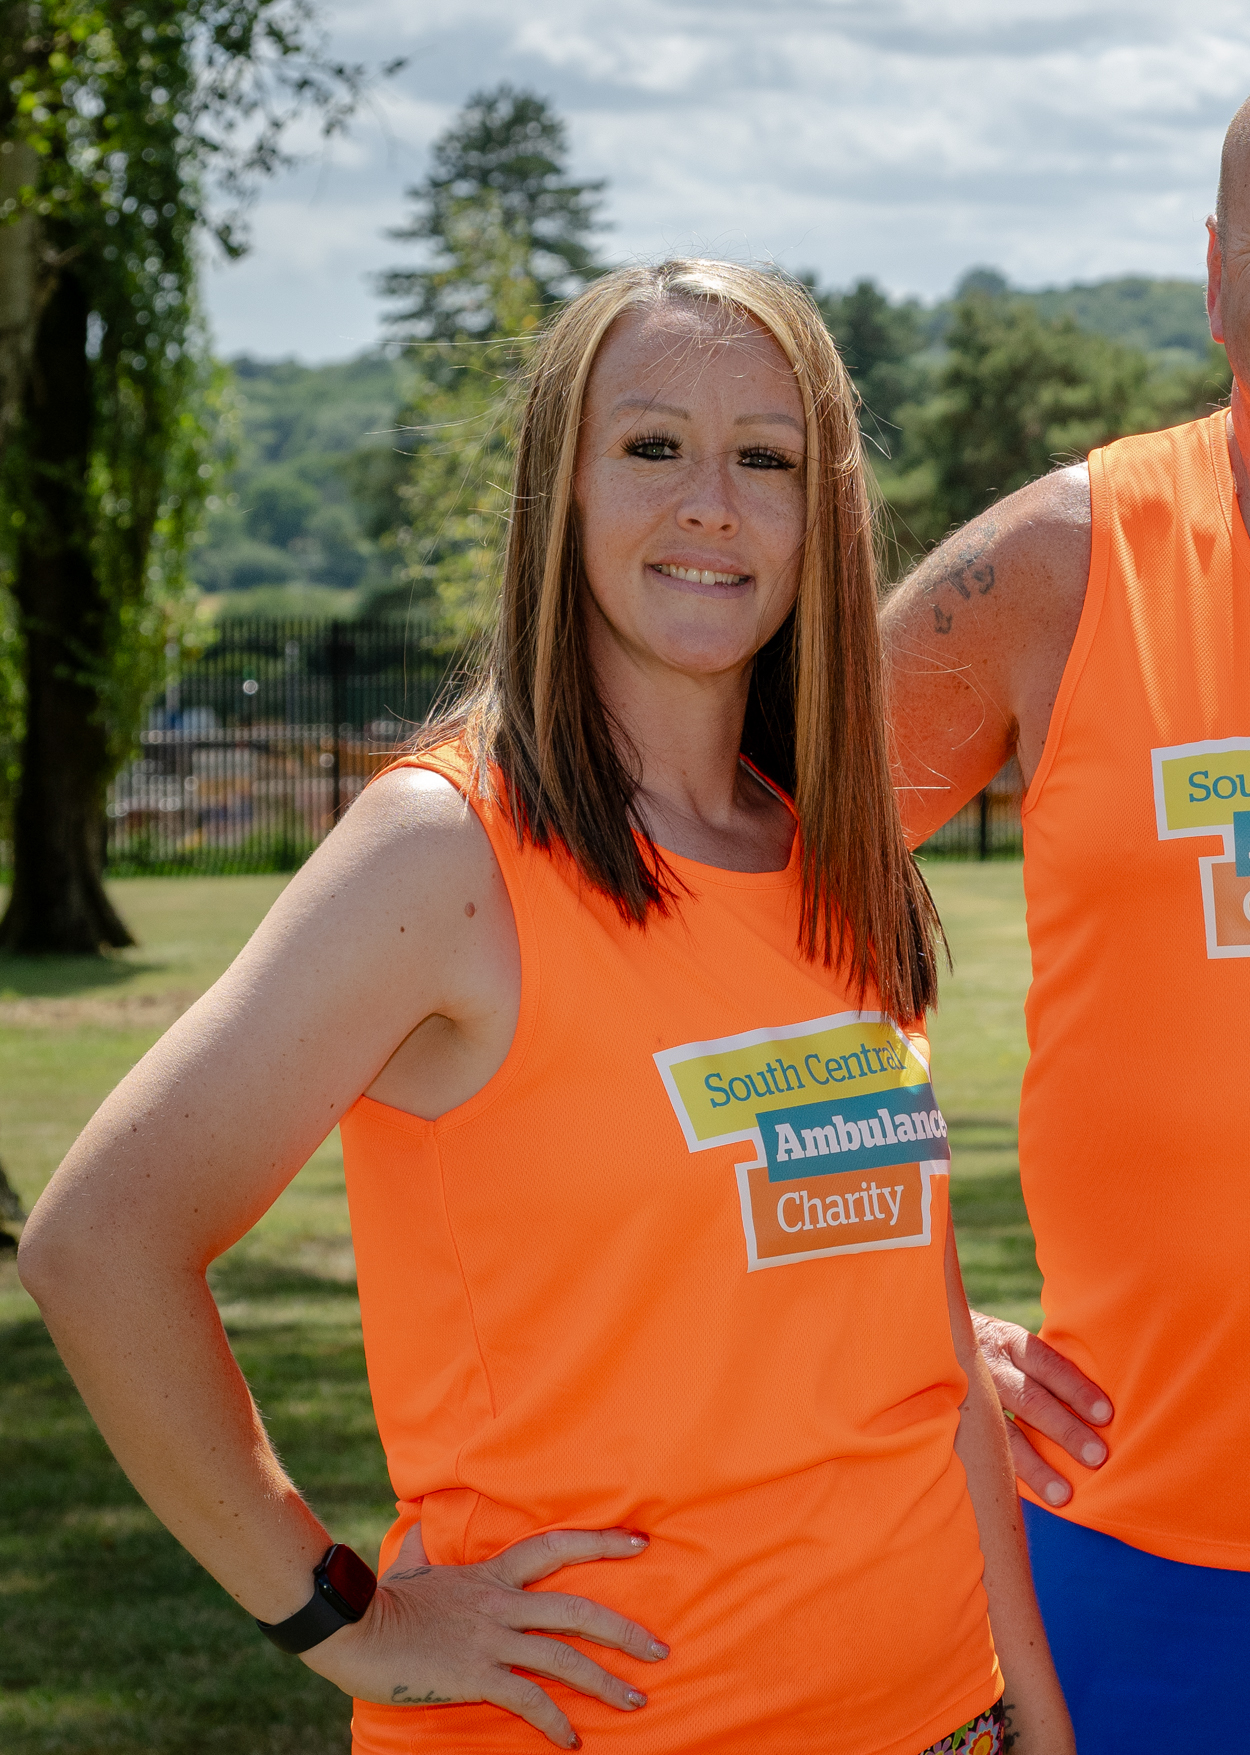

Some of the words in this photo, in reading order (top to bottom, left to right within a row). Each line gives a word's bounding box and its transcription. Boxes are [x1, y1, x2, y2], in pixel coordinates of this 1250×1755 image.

[704, 1059, 805, 1108] South
[804, 1040, 907, 1086] Central
[774, 1108, 947, 1163] Ambulance
[776, 1181, 904, 1233] Charity
